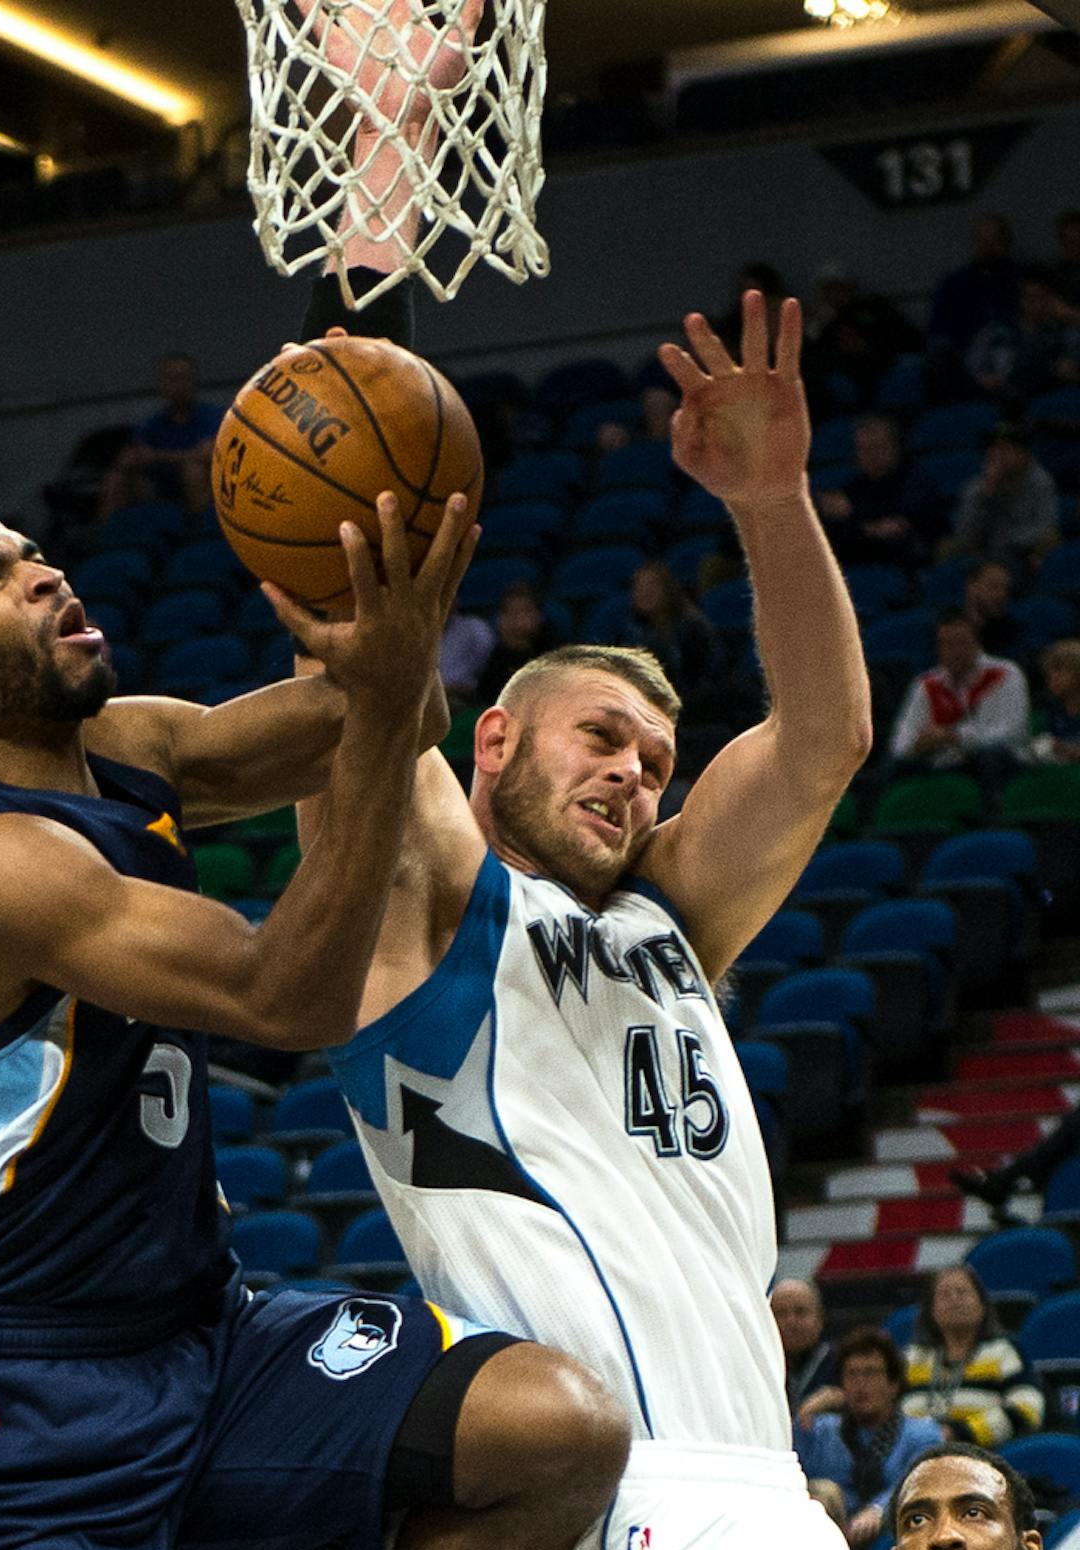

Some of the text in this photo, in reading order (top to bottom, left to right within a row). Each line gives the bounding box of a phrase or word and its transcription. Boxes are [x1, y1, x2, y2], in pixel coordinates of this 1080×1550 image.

[877, 138, 972, 198] 131
[255, 365, 351, 460] ALDING
[624, 1025, 731, 1161] 45
